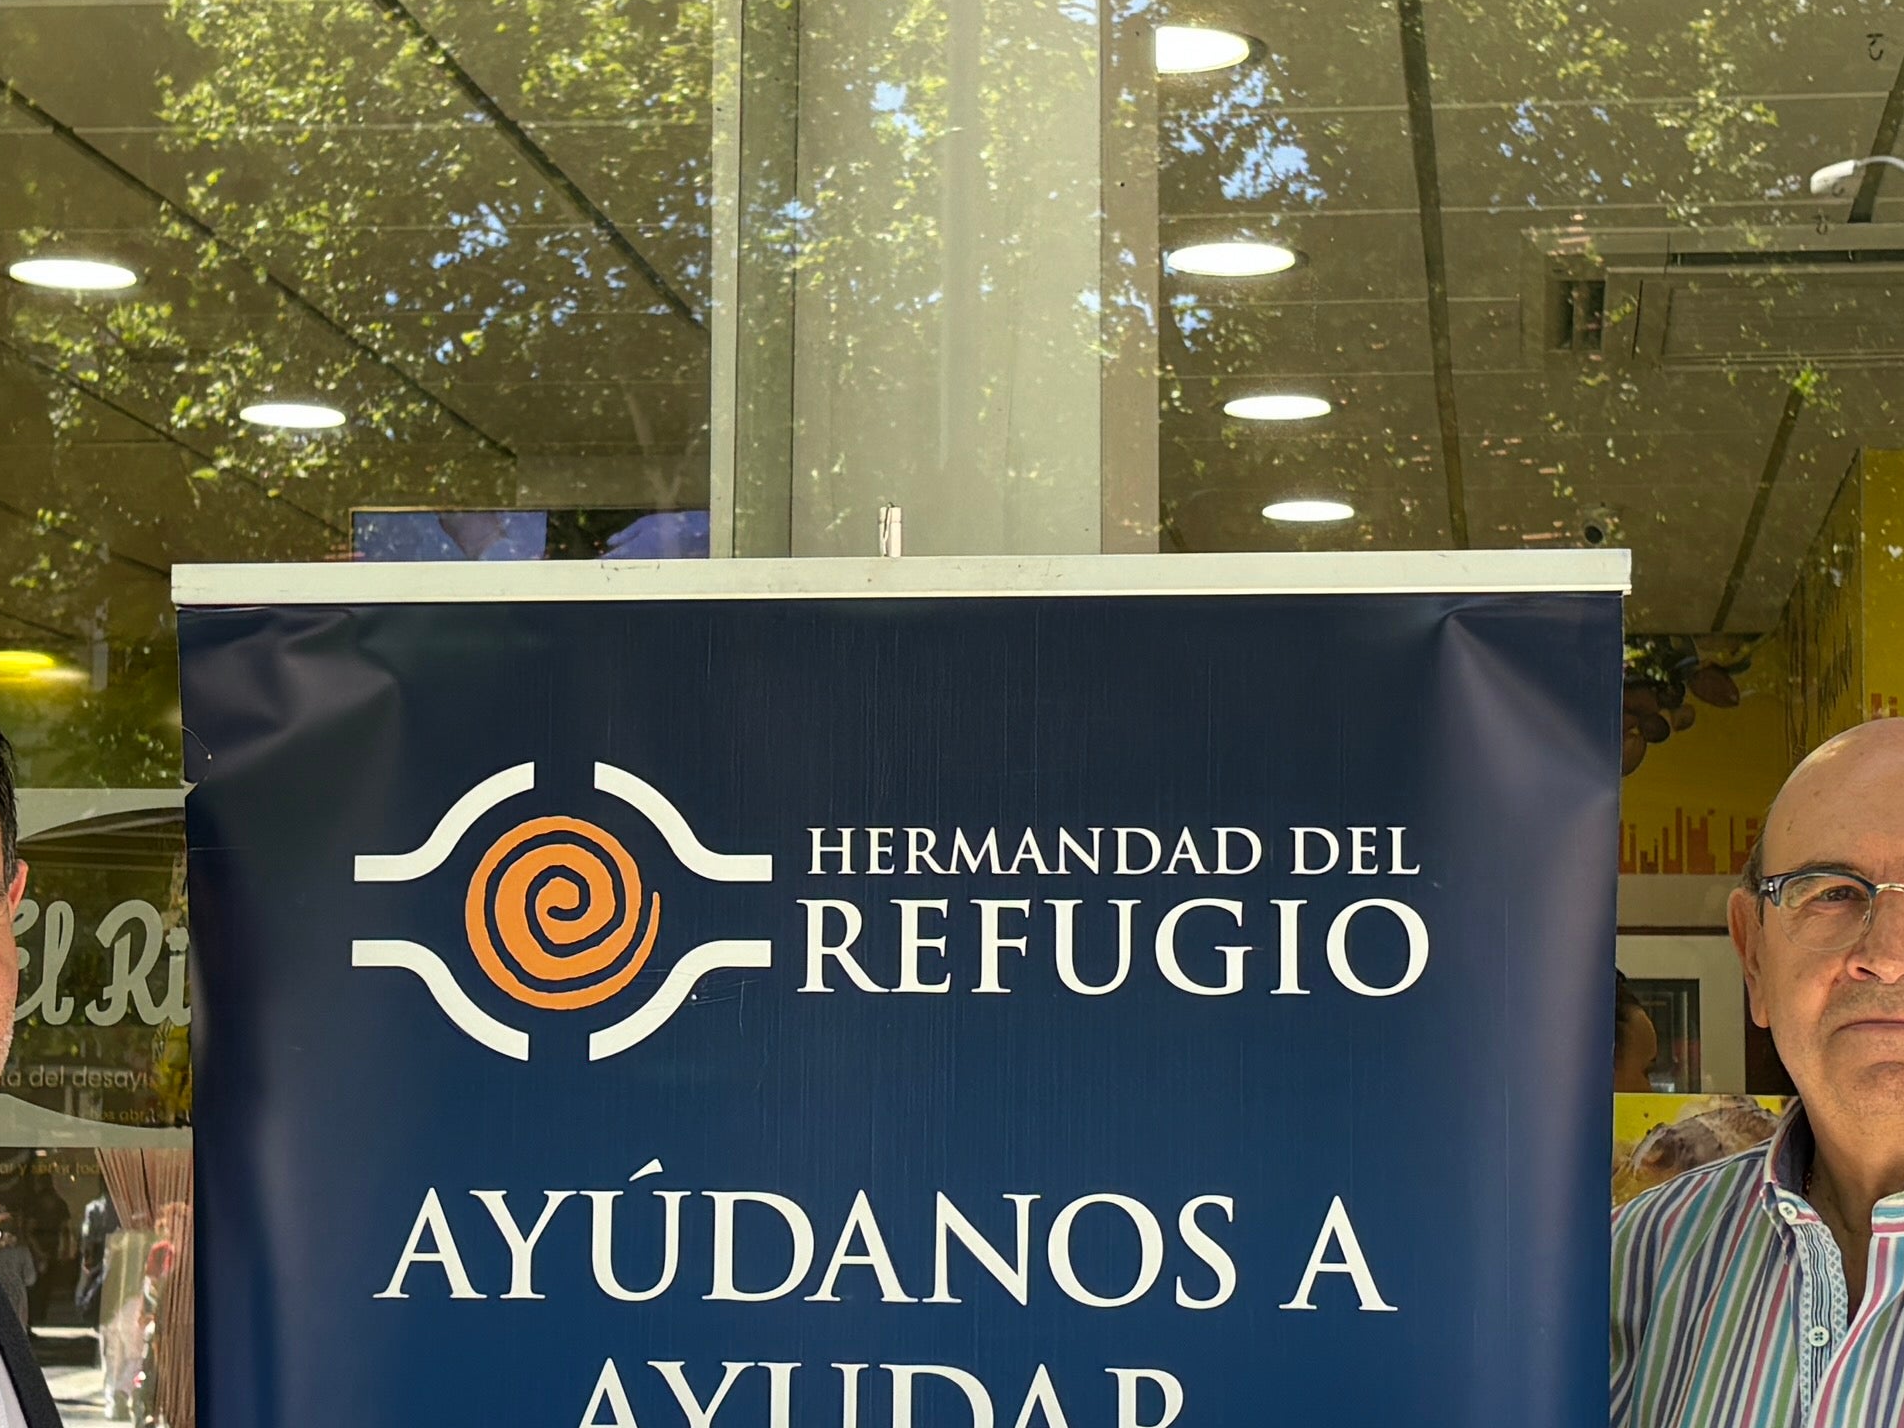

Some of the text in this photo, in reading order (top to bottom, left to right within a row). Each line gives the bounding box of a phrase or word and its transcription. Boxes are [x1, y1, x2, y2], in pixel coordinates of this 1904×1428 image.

[806, 827, 1421, 876] HERMANDAD DEL
[795, 897, 1431, 997] REFUGIO
[29, 1064, 64, 1088] del
[373, 1158, 1398, 1312] AYÚDANOS A
